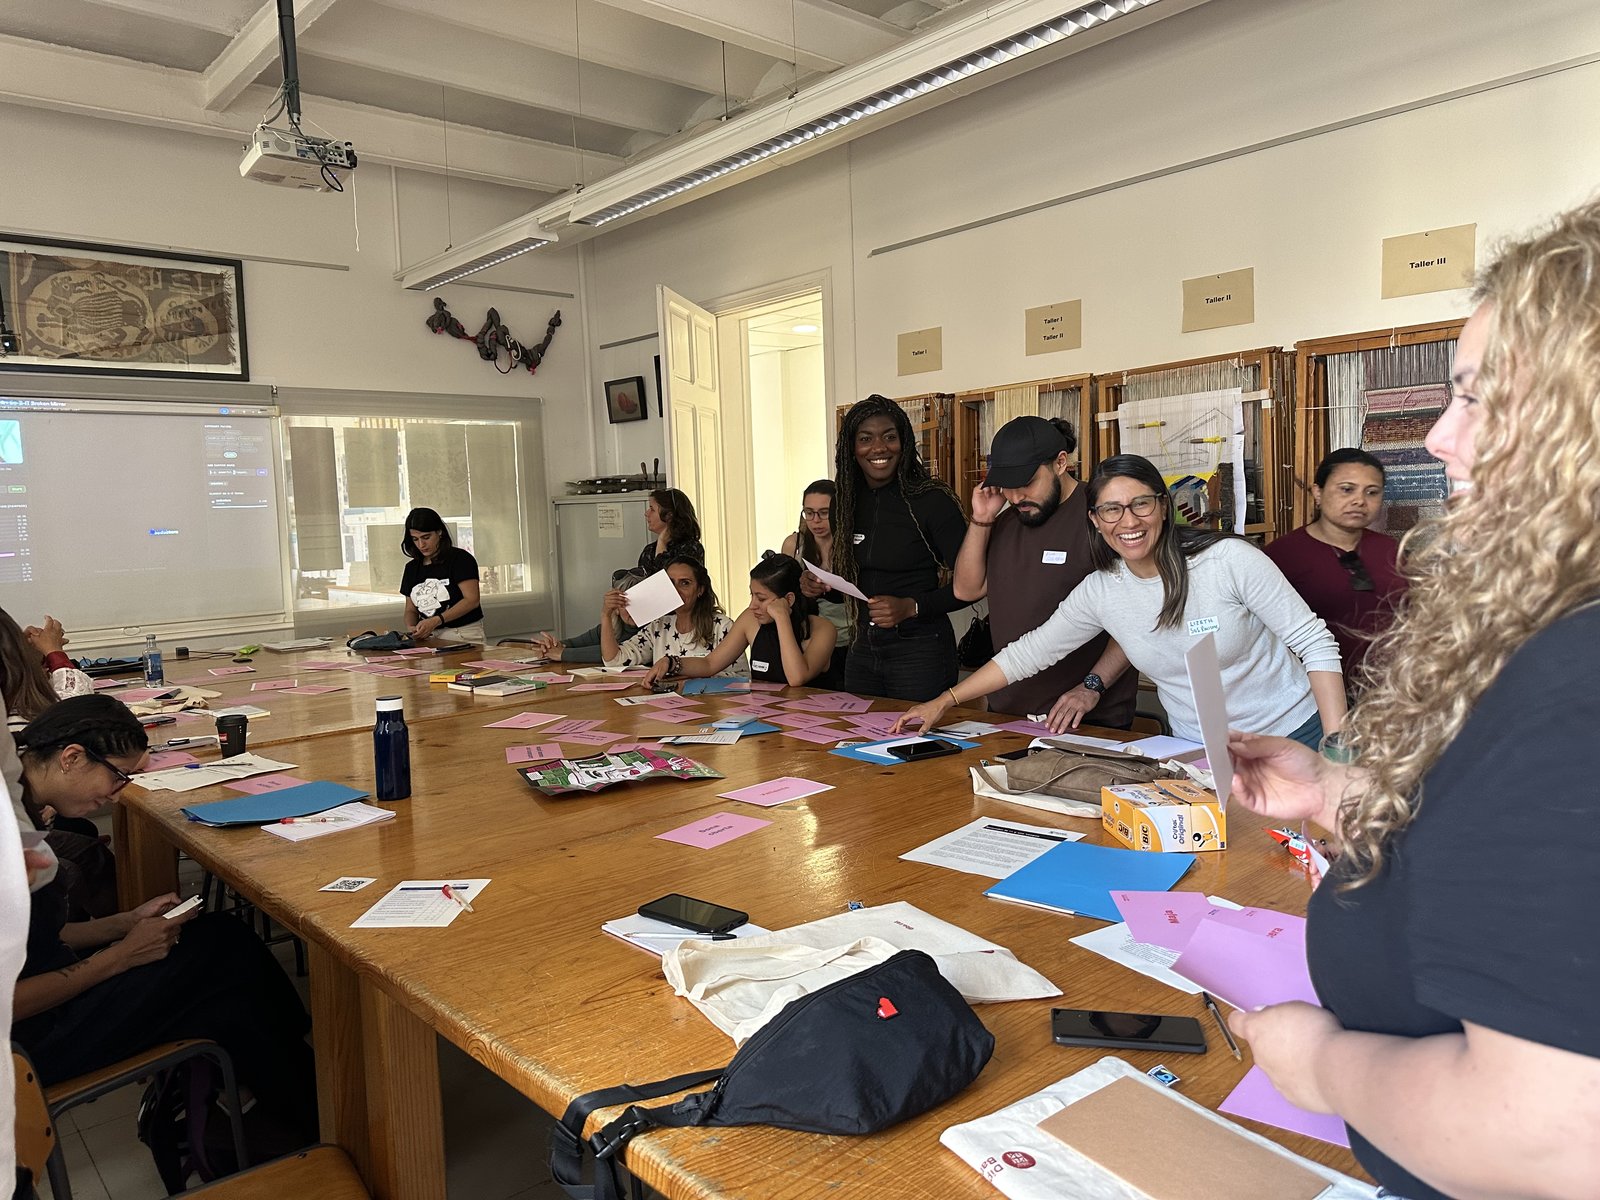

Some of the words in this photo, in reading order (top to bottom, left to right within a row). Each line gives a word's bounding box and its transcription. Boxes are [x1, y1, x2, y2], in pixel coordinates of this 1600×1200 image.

[1409, 260, 1434, 269] Taller
[1436, 257, 1446, 265] III
[1205, 296, 1225, 304] Taller
